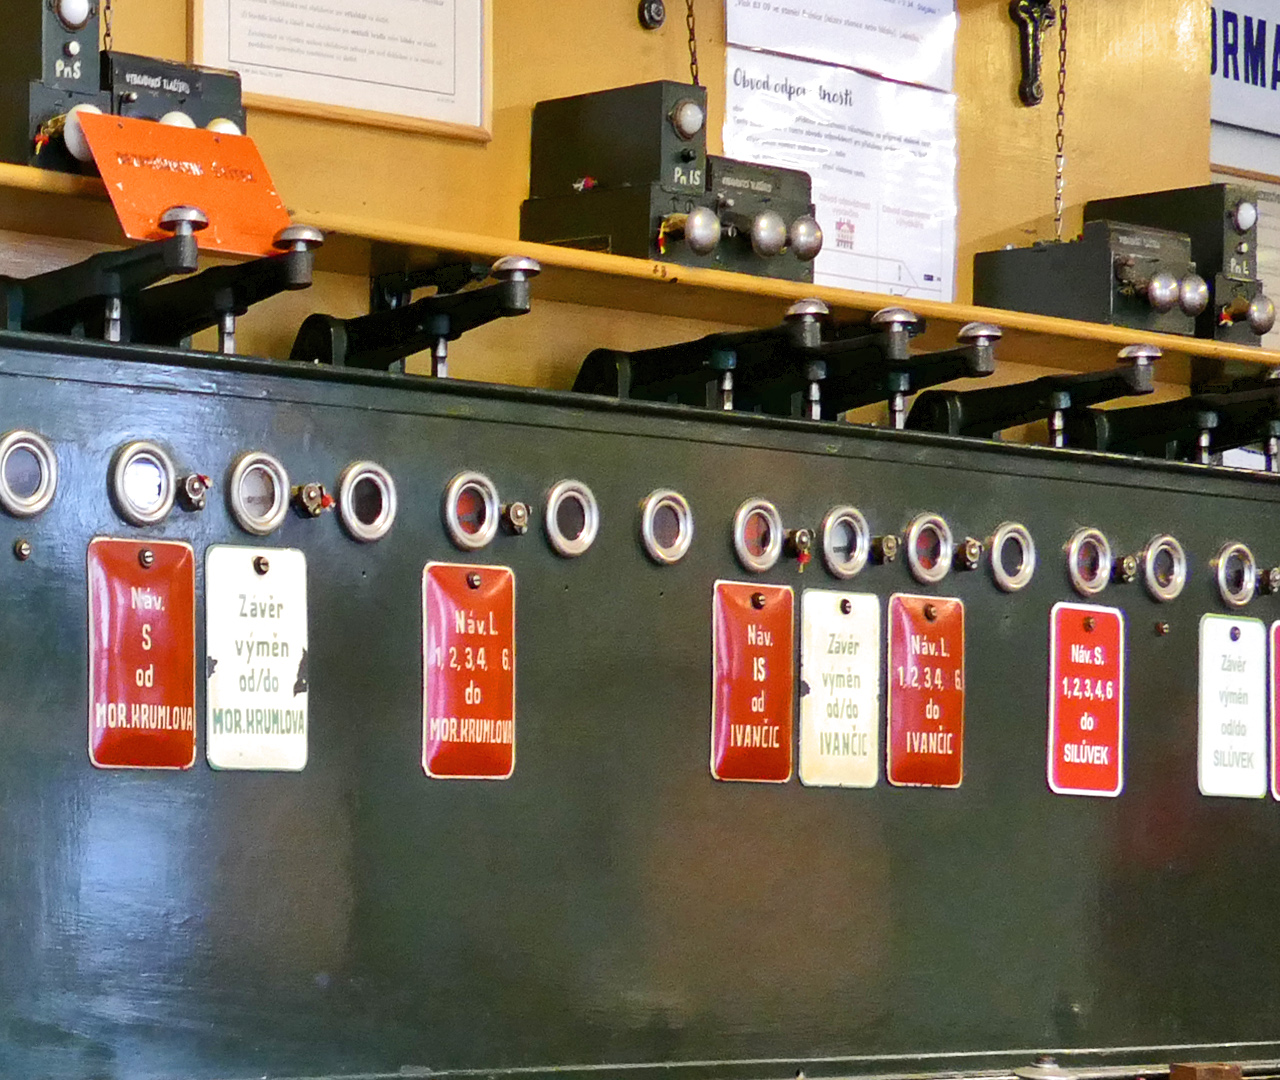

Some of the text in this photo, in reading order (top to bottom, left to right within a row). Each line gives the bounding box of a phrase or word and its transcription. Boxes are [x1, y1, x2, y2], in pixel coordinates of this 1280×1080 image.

[55, 58, 82, 80] PnS
[733, 67, 853, 107] Obvod odponosti
[131, 586, 166, 612] Náv.
[238, 593, 284, 619] Závěr
[454, 609, 487, 636] Náv.
[747, 623, 774, 647] Náv.
[141, 623, 152, 651] S
[235, 631, 289, 664] výměn
[827, 633, 860, 656] Závěr
[911, 634, 939, 657] Náv.
[1071, 643, 1105, 666] Náv. S.
[1220, 653, 1247, 673] Závěr
[135, 664, 154, 688] od
[239, 668, 280, 693] od/do
[821, 666, 861, 693] výměn
[464, 679, 481, 705] do
[750, 690, 765, 713] od
[1218, 686, 1249, 708] výměn
[826, 700, 859, 719] od/do
[925, 698, 940, 720] do
[1080, 711, 1094, 731] do
[730, 718, 780, 749] IVANČIC
[819, 726, 868, 757] IVANČIC
[906, 724, 953, 755] IVANČIC
[1063, 739, 1109, 766] SILŮVEK
[1212, 745, 1255, 770] SILŮVEK
